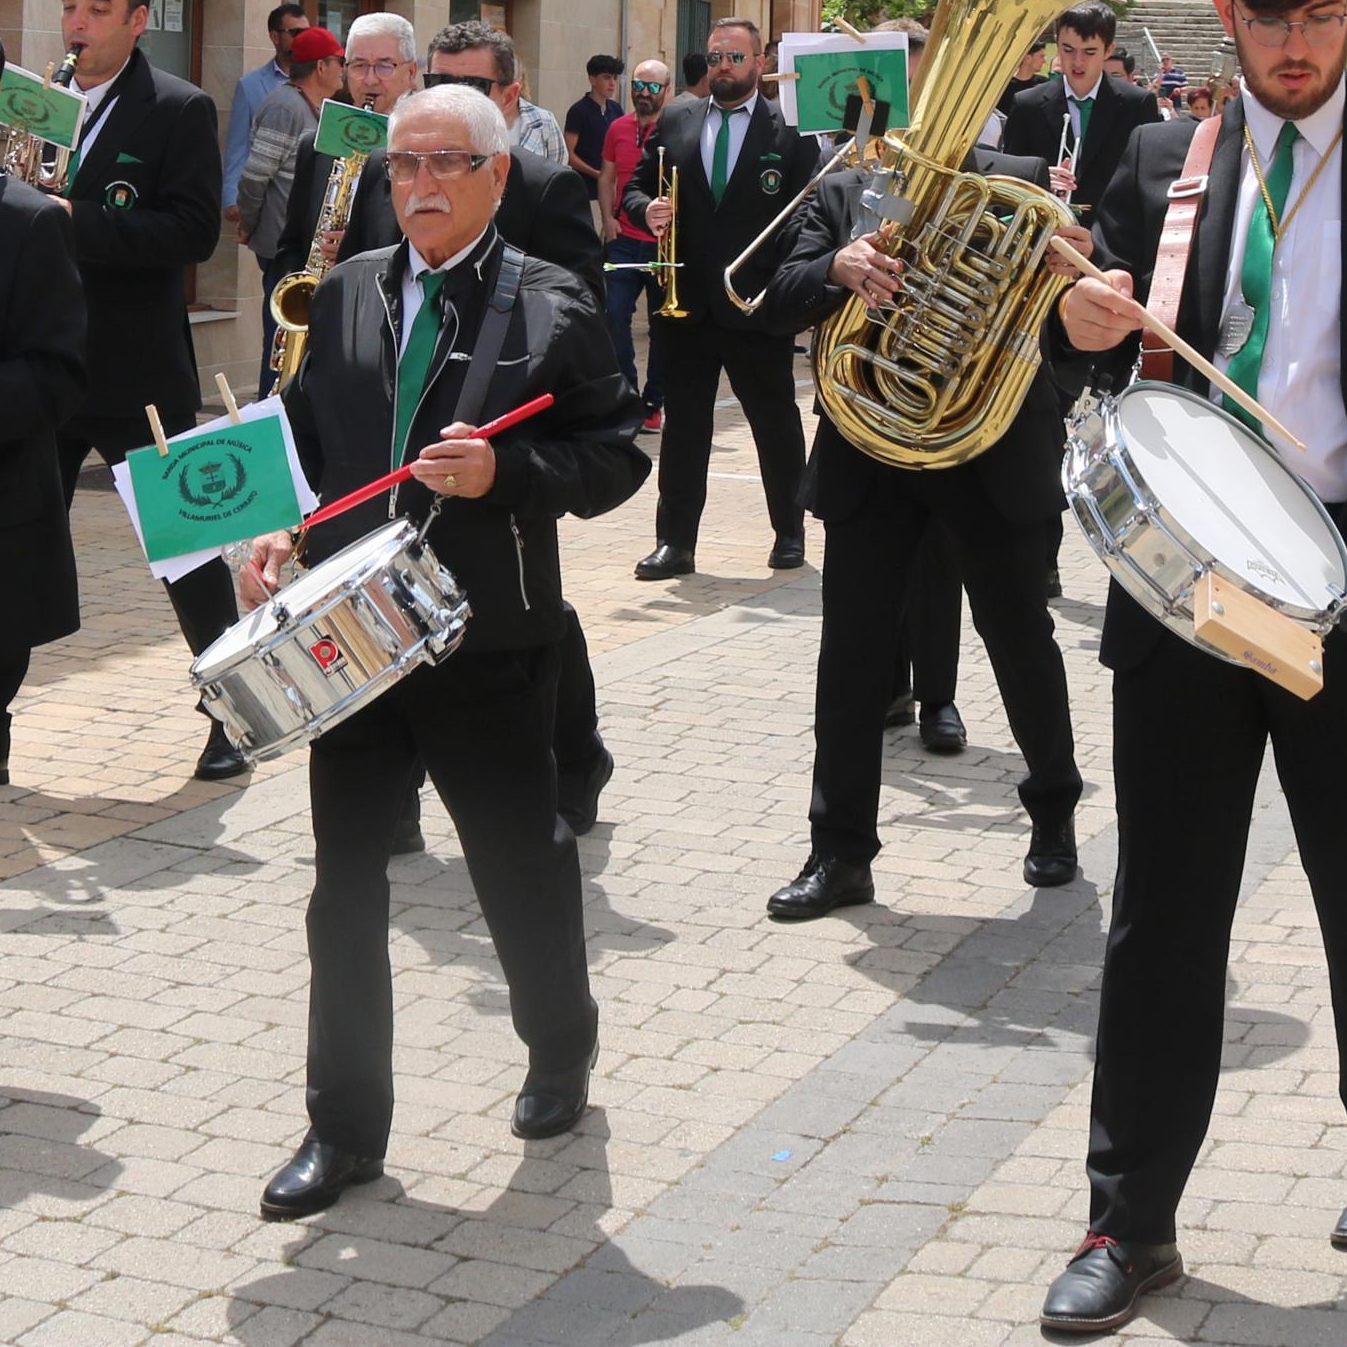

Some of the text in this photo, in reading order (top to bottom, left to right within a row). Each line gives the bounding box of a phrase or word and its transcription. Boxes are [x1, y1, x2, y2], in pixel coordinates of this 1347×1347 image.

[178, 440, 214, 460] MUNICIPAL
[179, 508, 221, 521] VILLAMURIEL
[223, 510, 232, 518] DE
